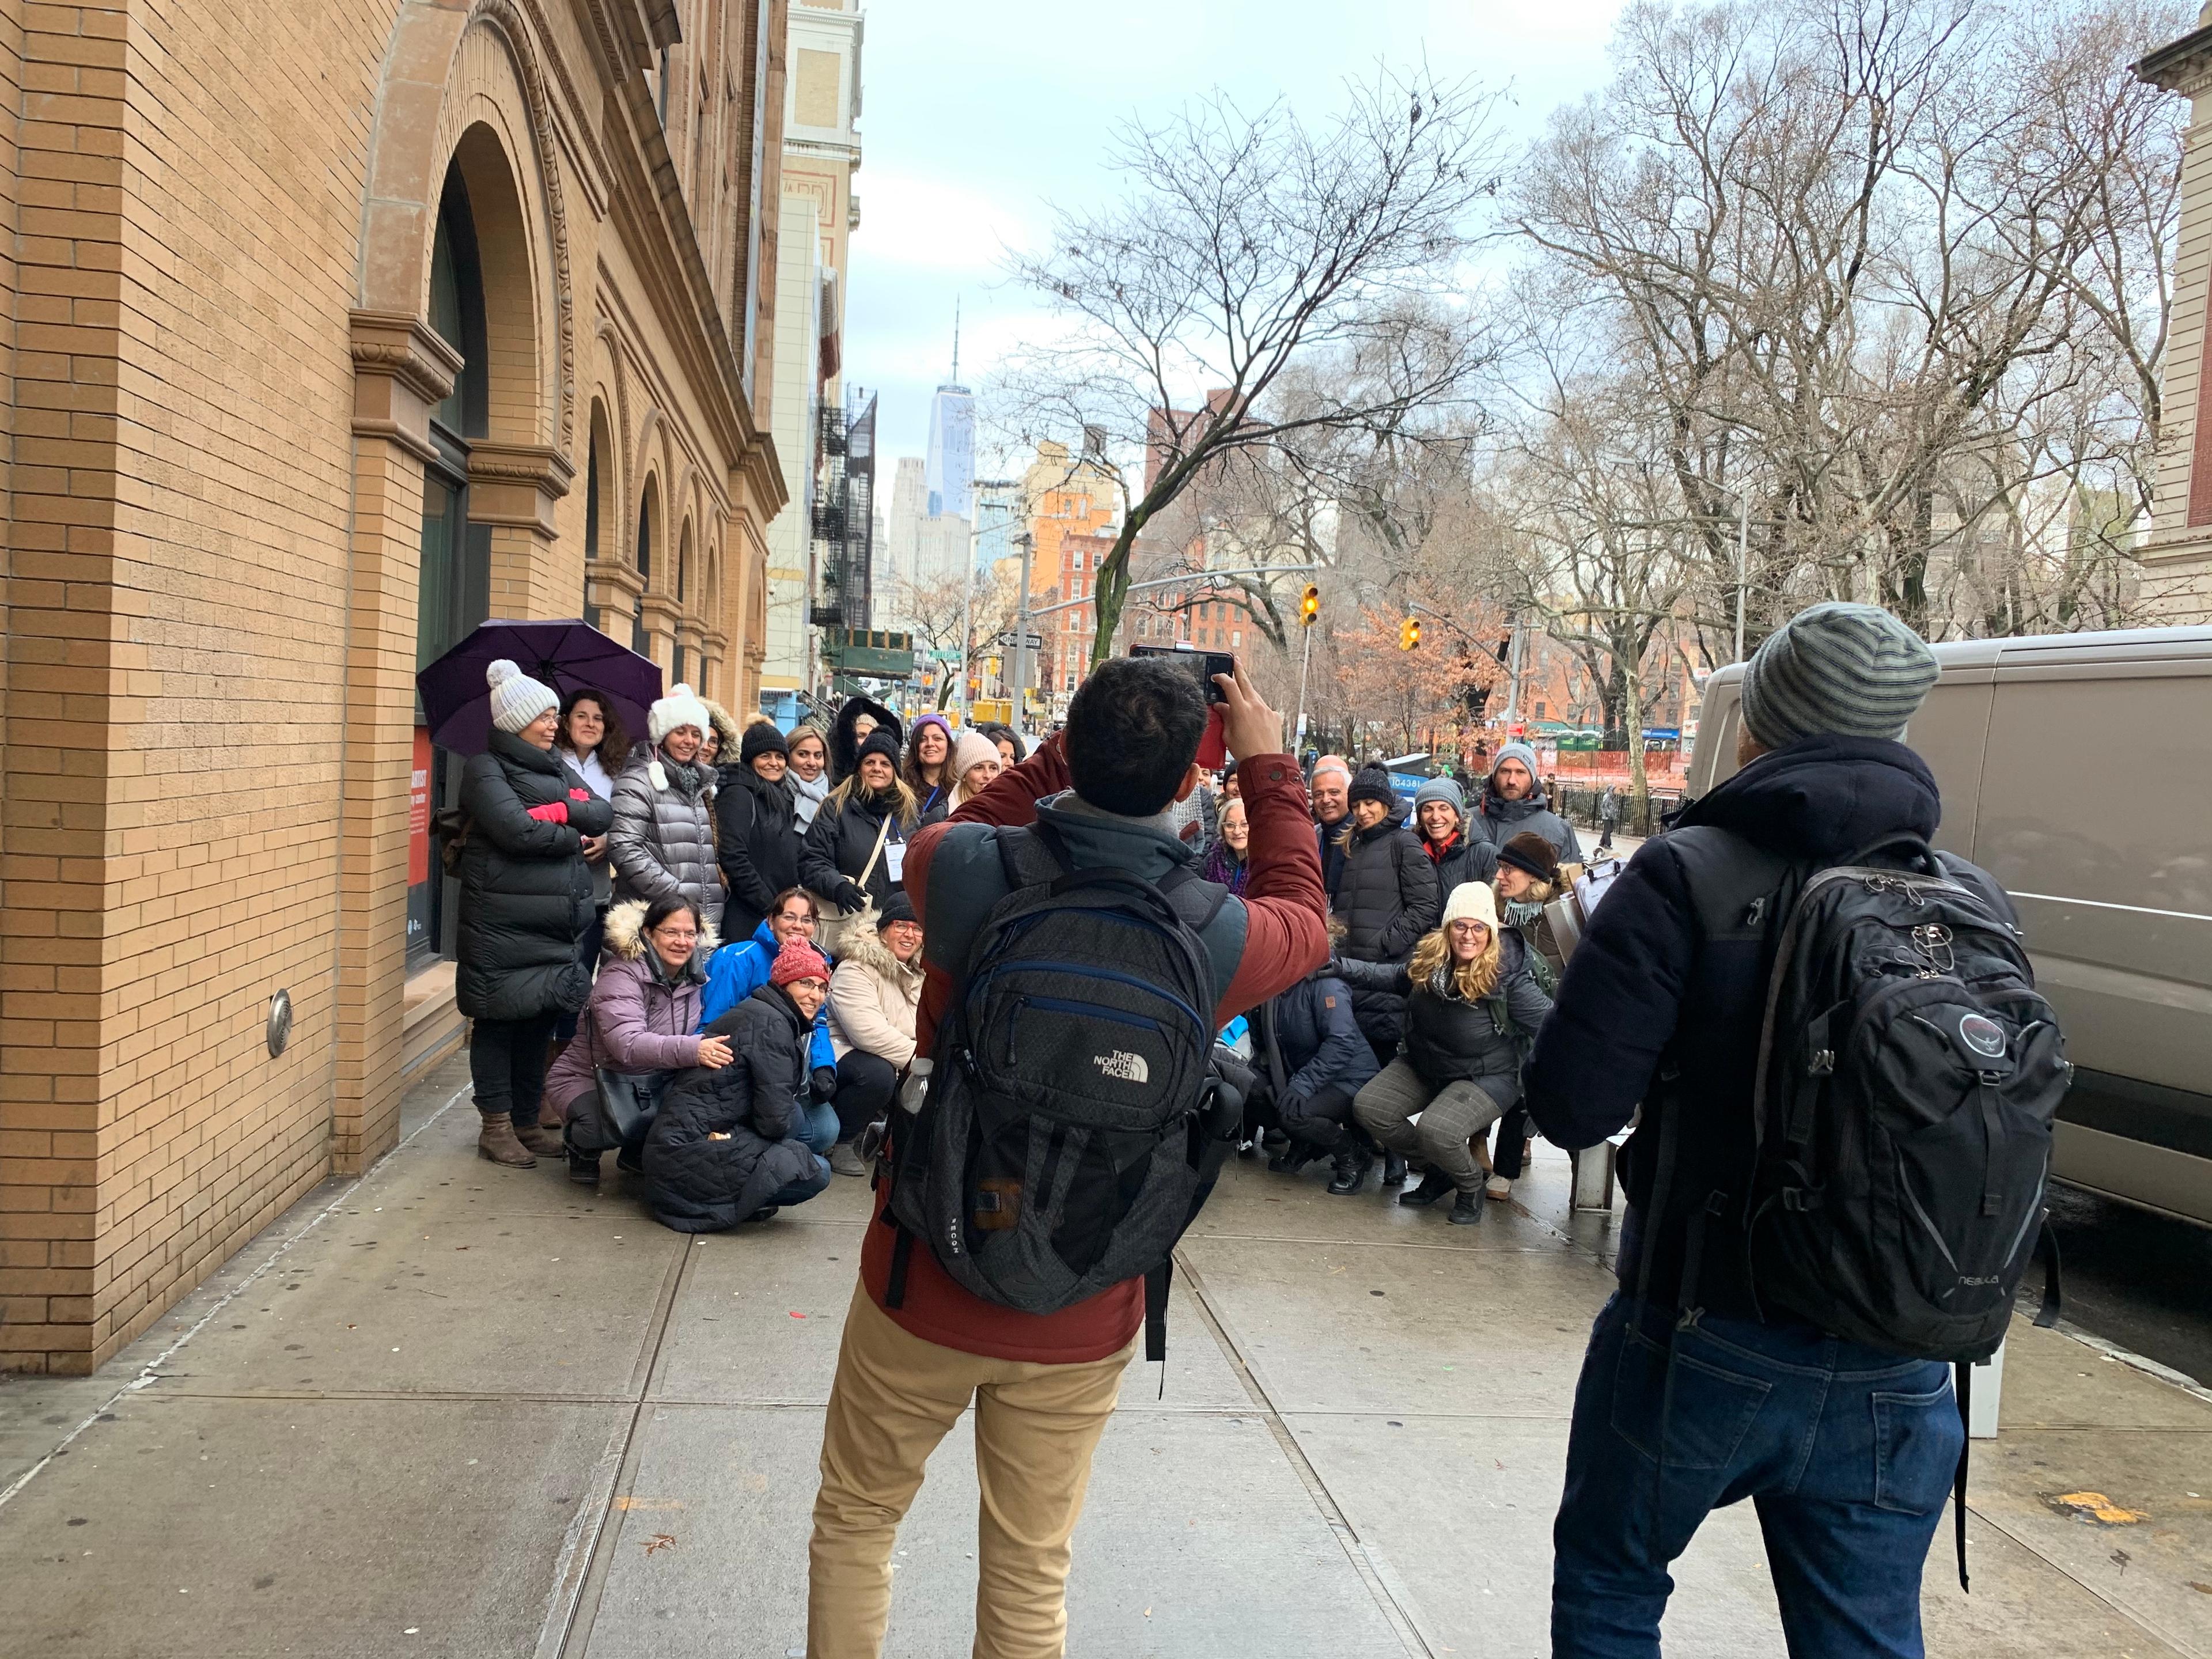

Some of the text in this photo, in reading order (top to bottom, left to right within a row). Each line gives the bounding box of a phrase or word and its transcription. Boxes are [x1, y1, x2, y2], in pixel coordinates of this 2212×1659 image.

[932, 651, 956, 659] JEFFERSON
[1392, 779, 1420, 787] 104381
[1112, 1050, 1134, 1062] THE
[1093, 1055, 1131, 1070] NORTH
[1101, 1066, 1130, 1079] FACE
